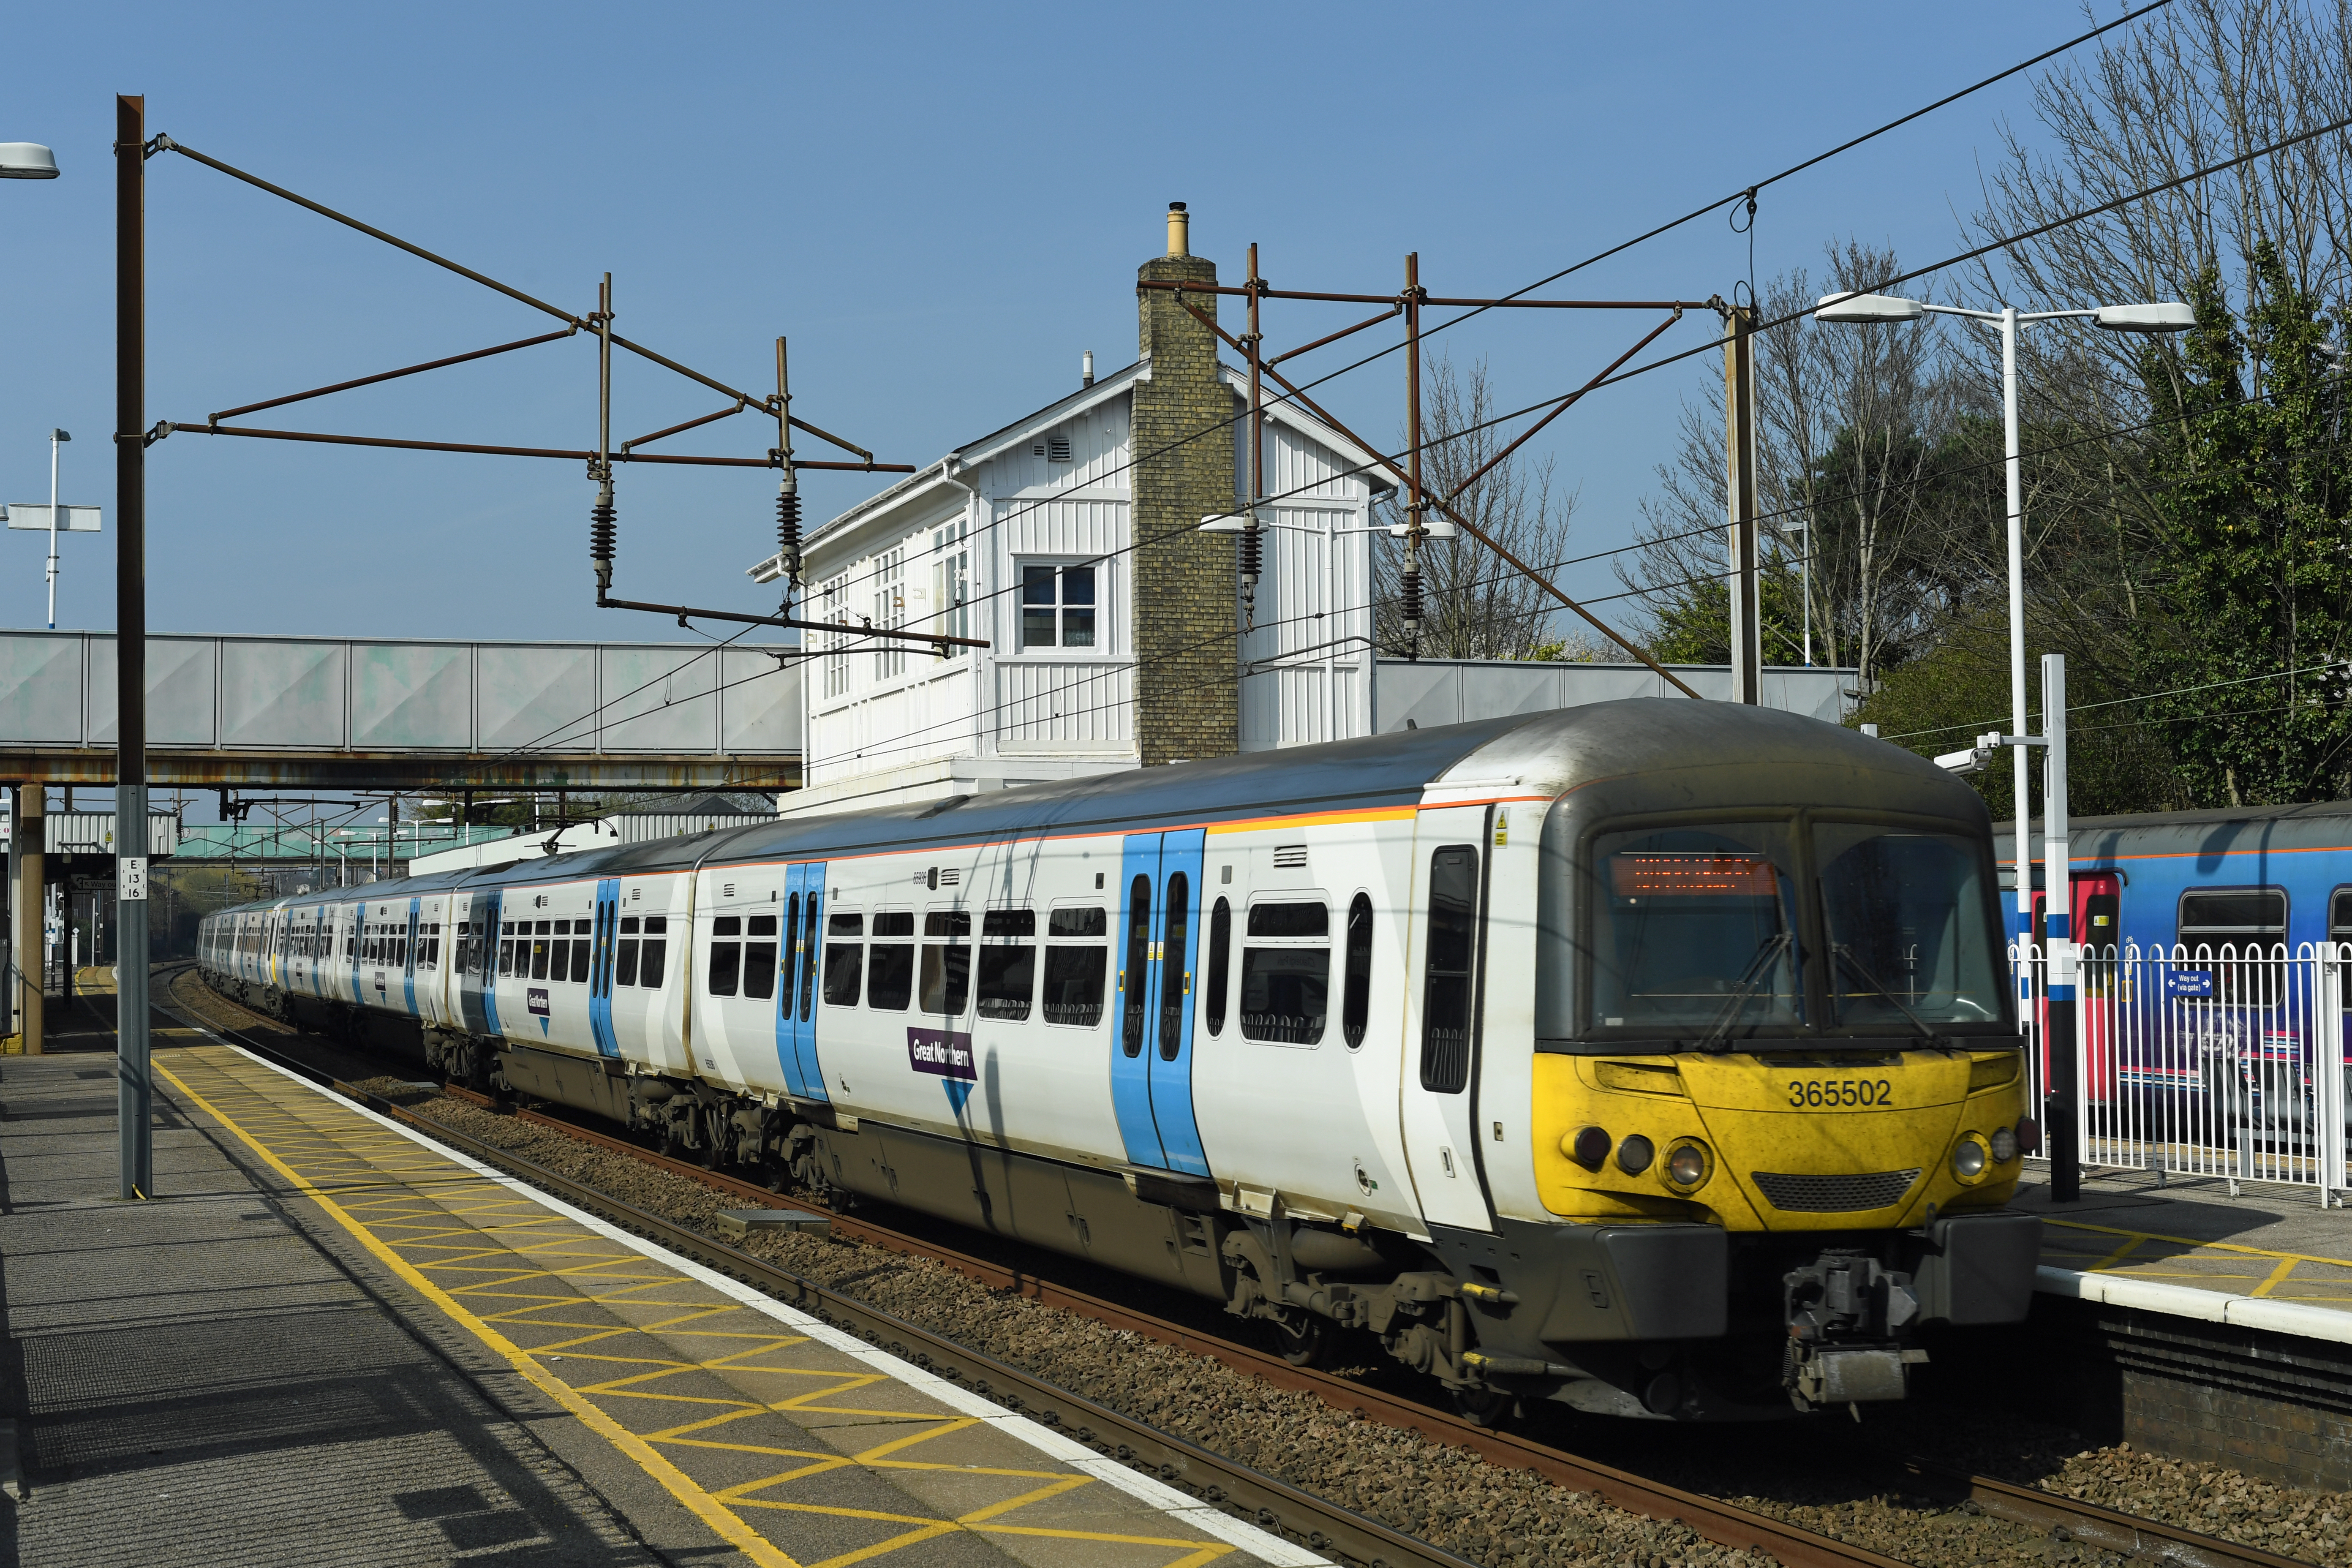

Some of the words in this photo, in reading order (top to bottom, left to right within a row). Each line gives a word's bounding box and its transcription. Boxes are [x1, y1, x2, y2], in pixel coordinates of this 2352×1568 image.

[131, 860, 137, 869] E
[129, 874, 139, 883] 13
[913, 871, 927, 885] 65936
[129, 888, 139, 898] 16
[2179, 975, 2190, 983] Way
[2177, 983, 2187, 992] (via
[2187, 984, 2201, 992] gate)
[913, 1038, 934, 1062] Great
[934, 1041, 969, 1067] Northern
[1789, 1080, 1892, 1107] 365502
